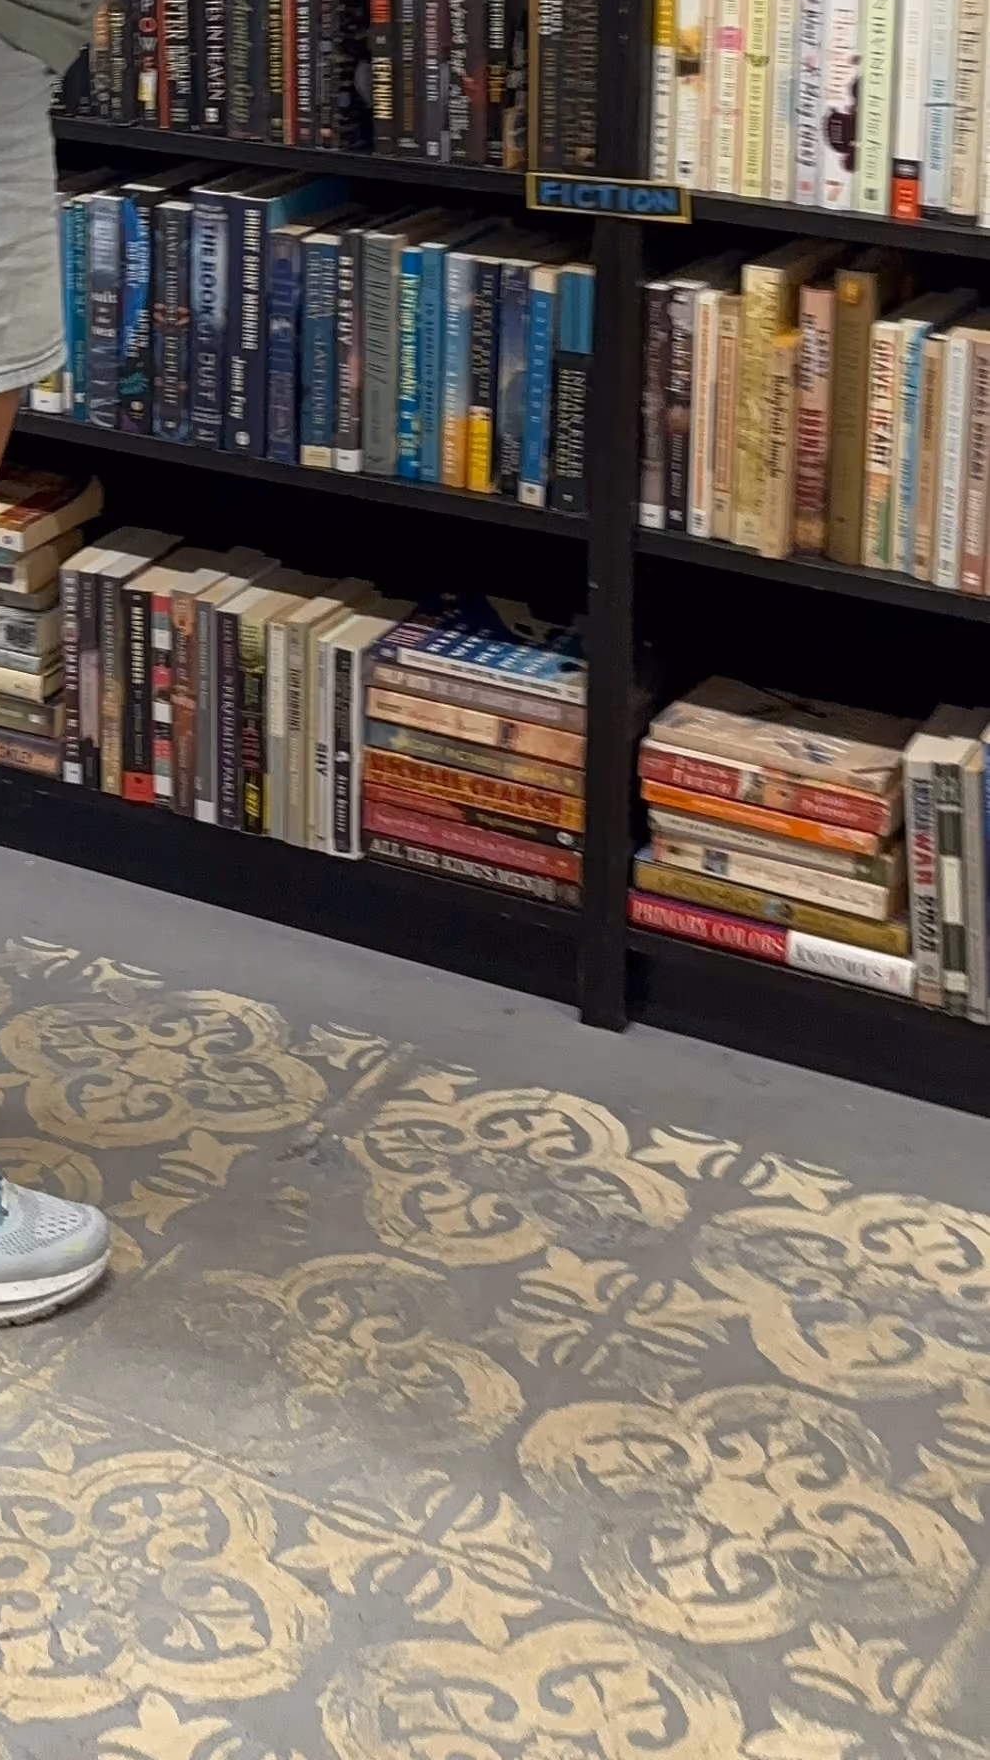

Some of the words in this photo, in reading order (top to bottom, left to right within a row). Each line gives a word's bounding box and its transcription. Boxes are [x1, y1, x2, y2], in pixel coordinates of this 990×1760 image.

[206, 25, 224, 42] IN
[296, 6, 310, 33] WITH
[296, 36, 310, 60] YOU
[206, 44, 226, 101] HEAVEN
[296, 63, 310, 113] TONIGHT
[371, 56, 393, 83] KEM
[371, 83, 394, 120] NUNN
[538, 180, 678, 212] FICTION
[201, 224, 219, 258] THE
[242, 208, 261, 253] BRIGHT
[201, 261, 218, 318] BOOK
[241, 255, 260, 291] SHINY
[339, 255, 354, 291] BED
[240, 293, 260, 350] MORNING
[338, 298, 354, 346] STUY
[197, 352, 216, 400] DUST
[229, 354, 248, 392] James
[872, 339, 896, 403] GRAVEL
[970, 355, 990, 416] ANIMAL
[227, 394, 247, 420] Frey
[572, 370, 587, 423] INDIAN
[572, 426, 587, 479] KILLER
[866, 408, 894, 470] HEART
[131, 606, 144, 640] MAGPIE
[131, 641, 144, 685] MURDERS
[314, 741, 329, 776] SHY
